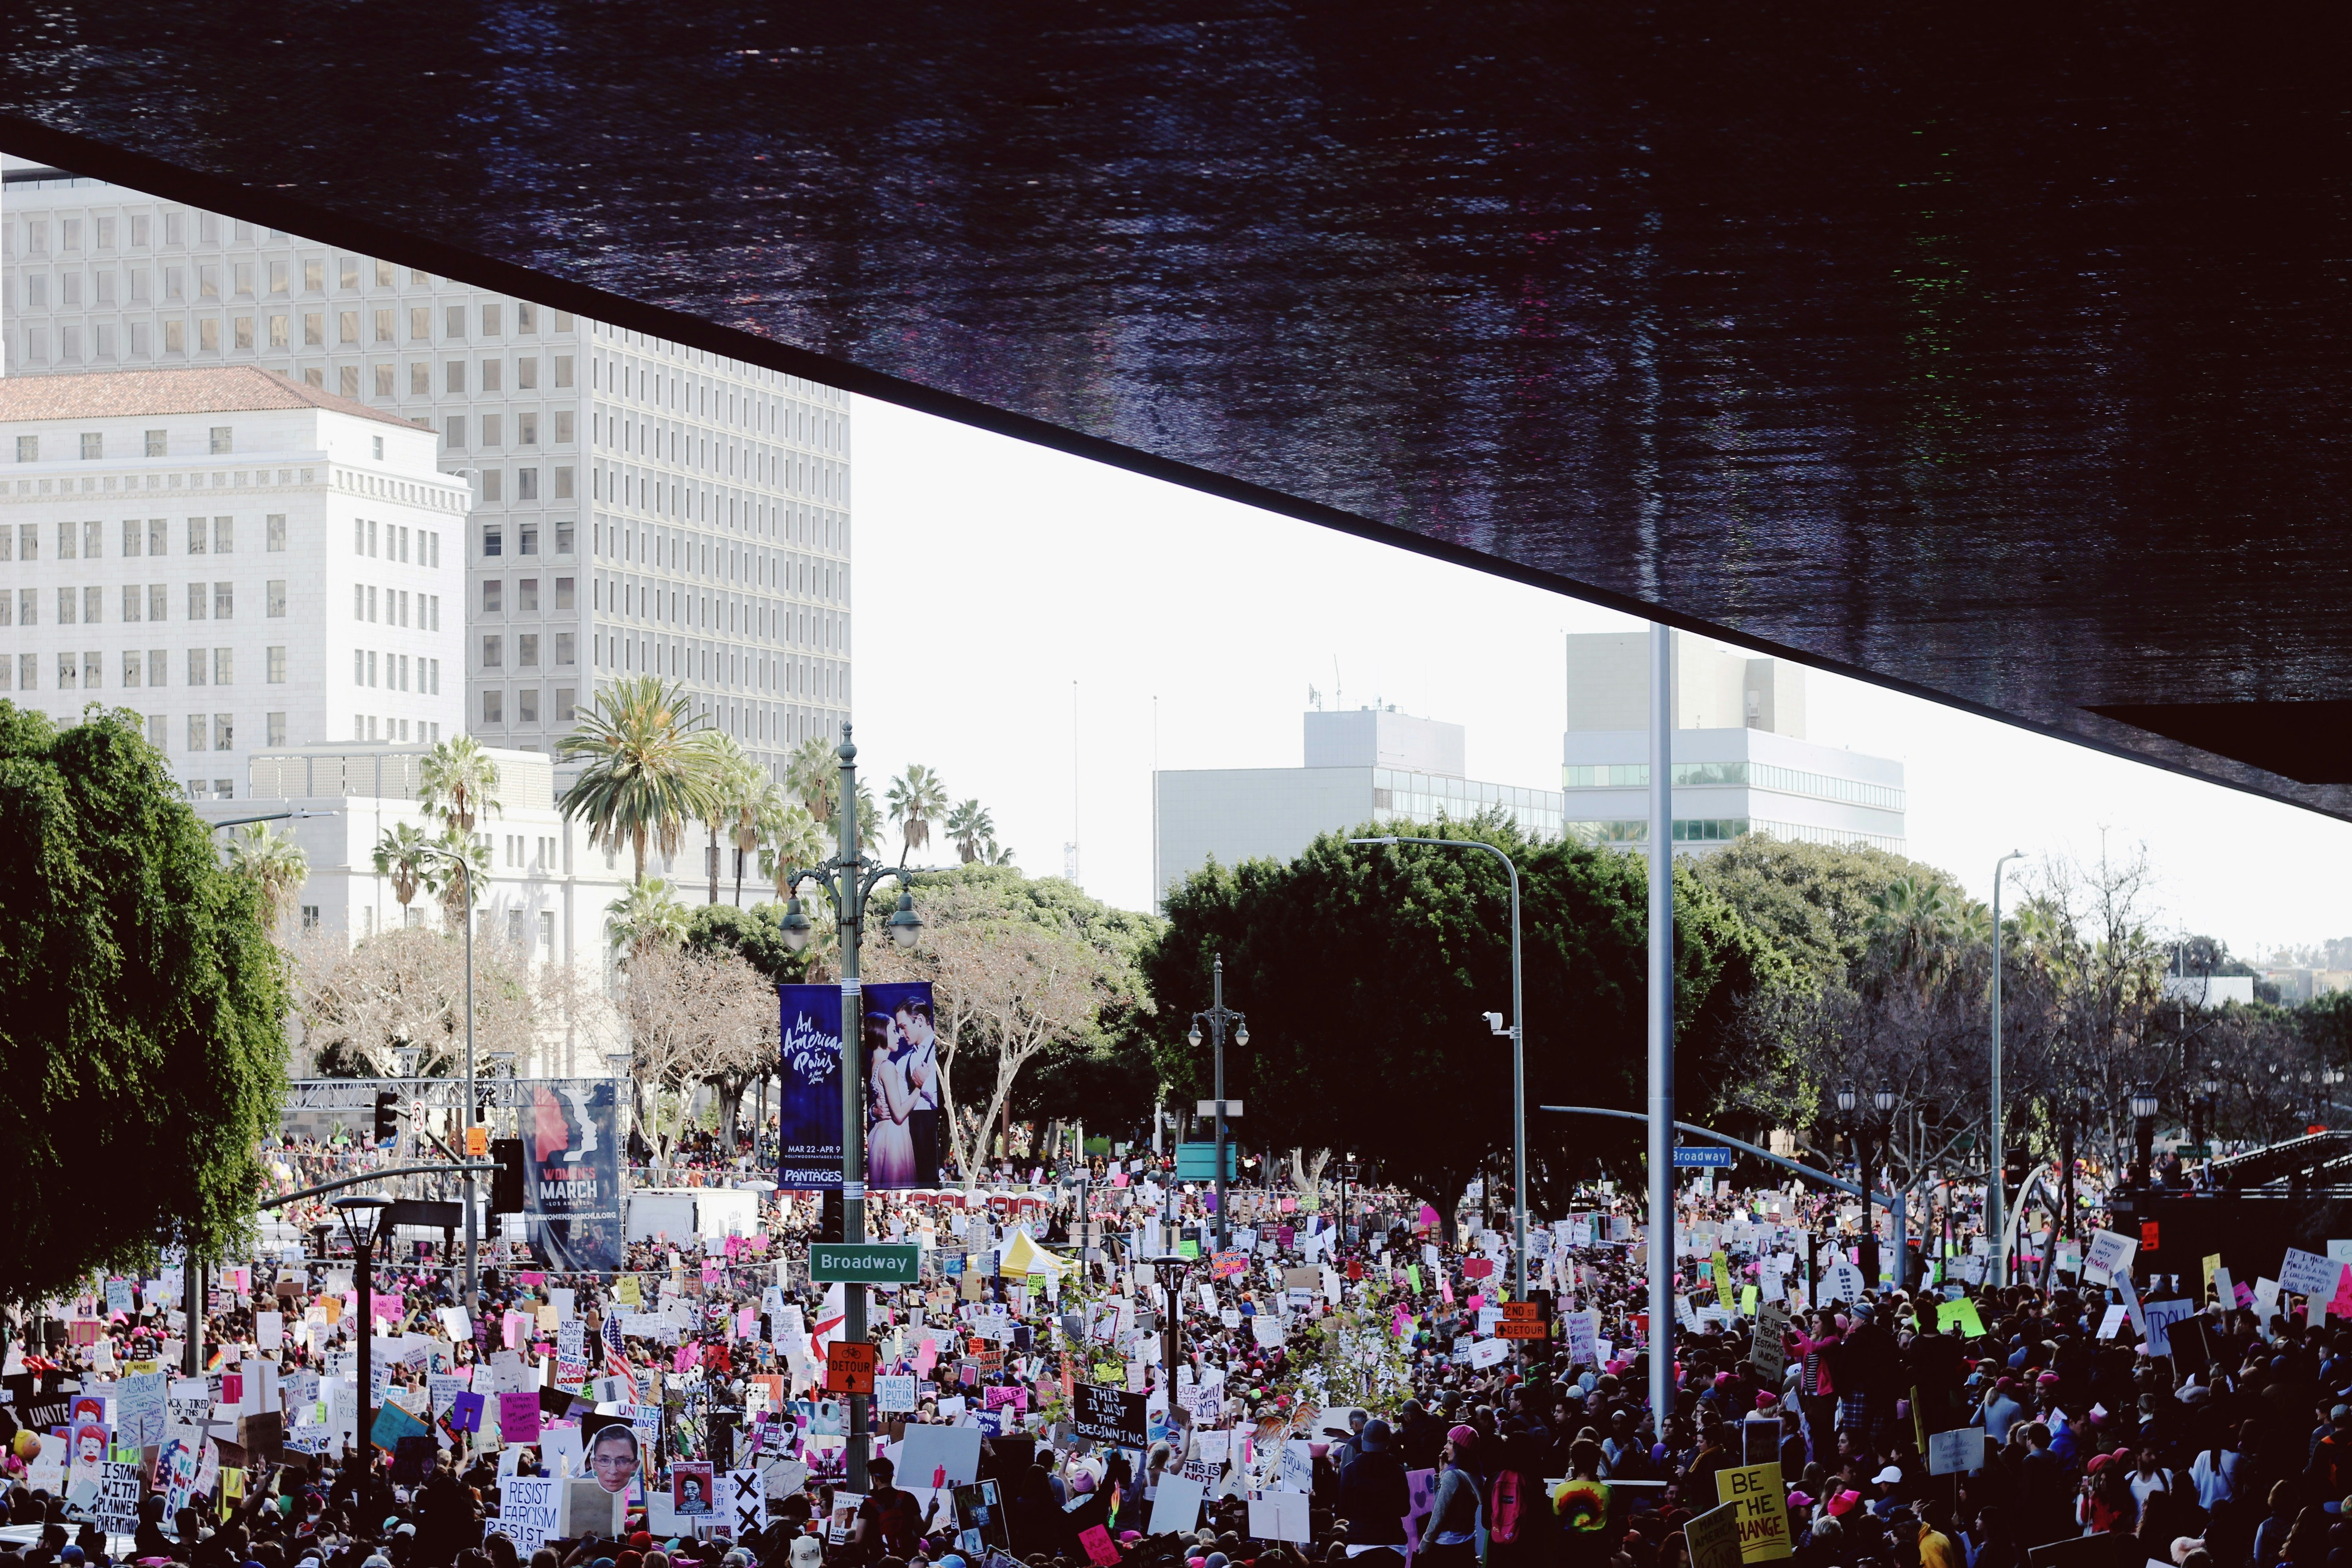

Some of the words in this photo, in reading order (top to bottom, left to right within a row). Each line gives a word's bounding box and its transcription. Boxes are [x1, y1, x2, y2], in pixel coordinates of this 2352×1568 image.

[794, 1052, 835, 1074] Paris
[1674, 1151, 1726, 1163] Broadway
[543, 1167, 596, 1180] WOMEN'S
[785, 1170, 843, 1182] PANTAGES
[540, 1181, 598, 1199] MARCH
[527, 1212, 616, 1221] WWWOMENSMARCHLA.ORG
[2095, 1249, 2112, 1258] UNITY
[821, 1255, 907, 1272] Broadway
[1225, 1264, 1245, 1274] BITCH
[2087, 1256, 2109, 1271] POWER
[1505, 1306, 1524, 1316] 2ND
[559, 1329, 583, 1338] READY
[1507, 1326, 1543, 1335] DETOUR
[559, 1343, 583, 1355] NICE!
[1754, 1337, 1784, 1356] ESTAMOS
[328, 1352, 353, 1360] POWER
[978, 1352, 1001, 1362] HATE
[559, 1362, 586, 1377] ROAR
[832, 1361, 870, 1375] DETOUR
[117, 1376, 148, 1389] STAND
[152, 1373, 164, 1384] UP
[560, 1384, 578, 1392] THAN
[886, 1379, 911, 1389] NAZIS
[125, 1384, 157, 1395] AGAINST
[886, 1390, 911, 1400] PUTIN
[987, 1388, 1025, 1405] EXCELLENT
[1089, 1387, 1120, 1402] THIS
[1178, 1386, 1198, 1396] OUR
[189, 1399, 209, 1410] TIRED
[505, 1395, 536, 1404] Women's
[887, 1399, 913, 1409] TRUMP
[1087, 1398, 1099, 1411] IS
[1102, 1402, 1127, 1417] JUST
[28, 1403, 69, 1427] UNITE
[1097, 1413, 1118, 1426] THE
[1075, 1421, 1145, 1446] BEGINNING
[283, 1439, 311, 1453] ENOUGH
[101, 1462, 112, 1479] I
[113, 1465, 137, 1481] STAN
[180, 1456, 191, 1475] WE
[1183, 1461, 1205, 1474] THIS
[1208, 1465, 1220, 1476] IS
[730, 1481, 760, 1491] DOLD
[1184, 1473, 1215, 1485] NOT
[1731, 1470, 1764, 1495] BE
[102, 1480, 137, 1499] WITH
[509, 1481, 552, 1504] RESIST
[97, 1498, 137, 1516] PLANNED
[1732, 1493, 1775, 1518] THE
[1699, 1510, 1725, 1532] MAKE
[488, 1520, 544, 1544] RESIST
[1694, 1521, 1735, 1550] AMERICA
[1736, 1514, 1785, 1543] HANGE
